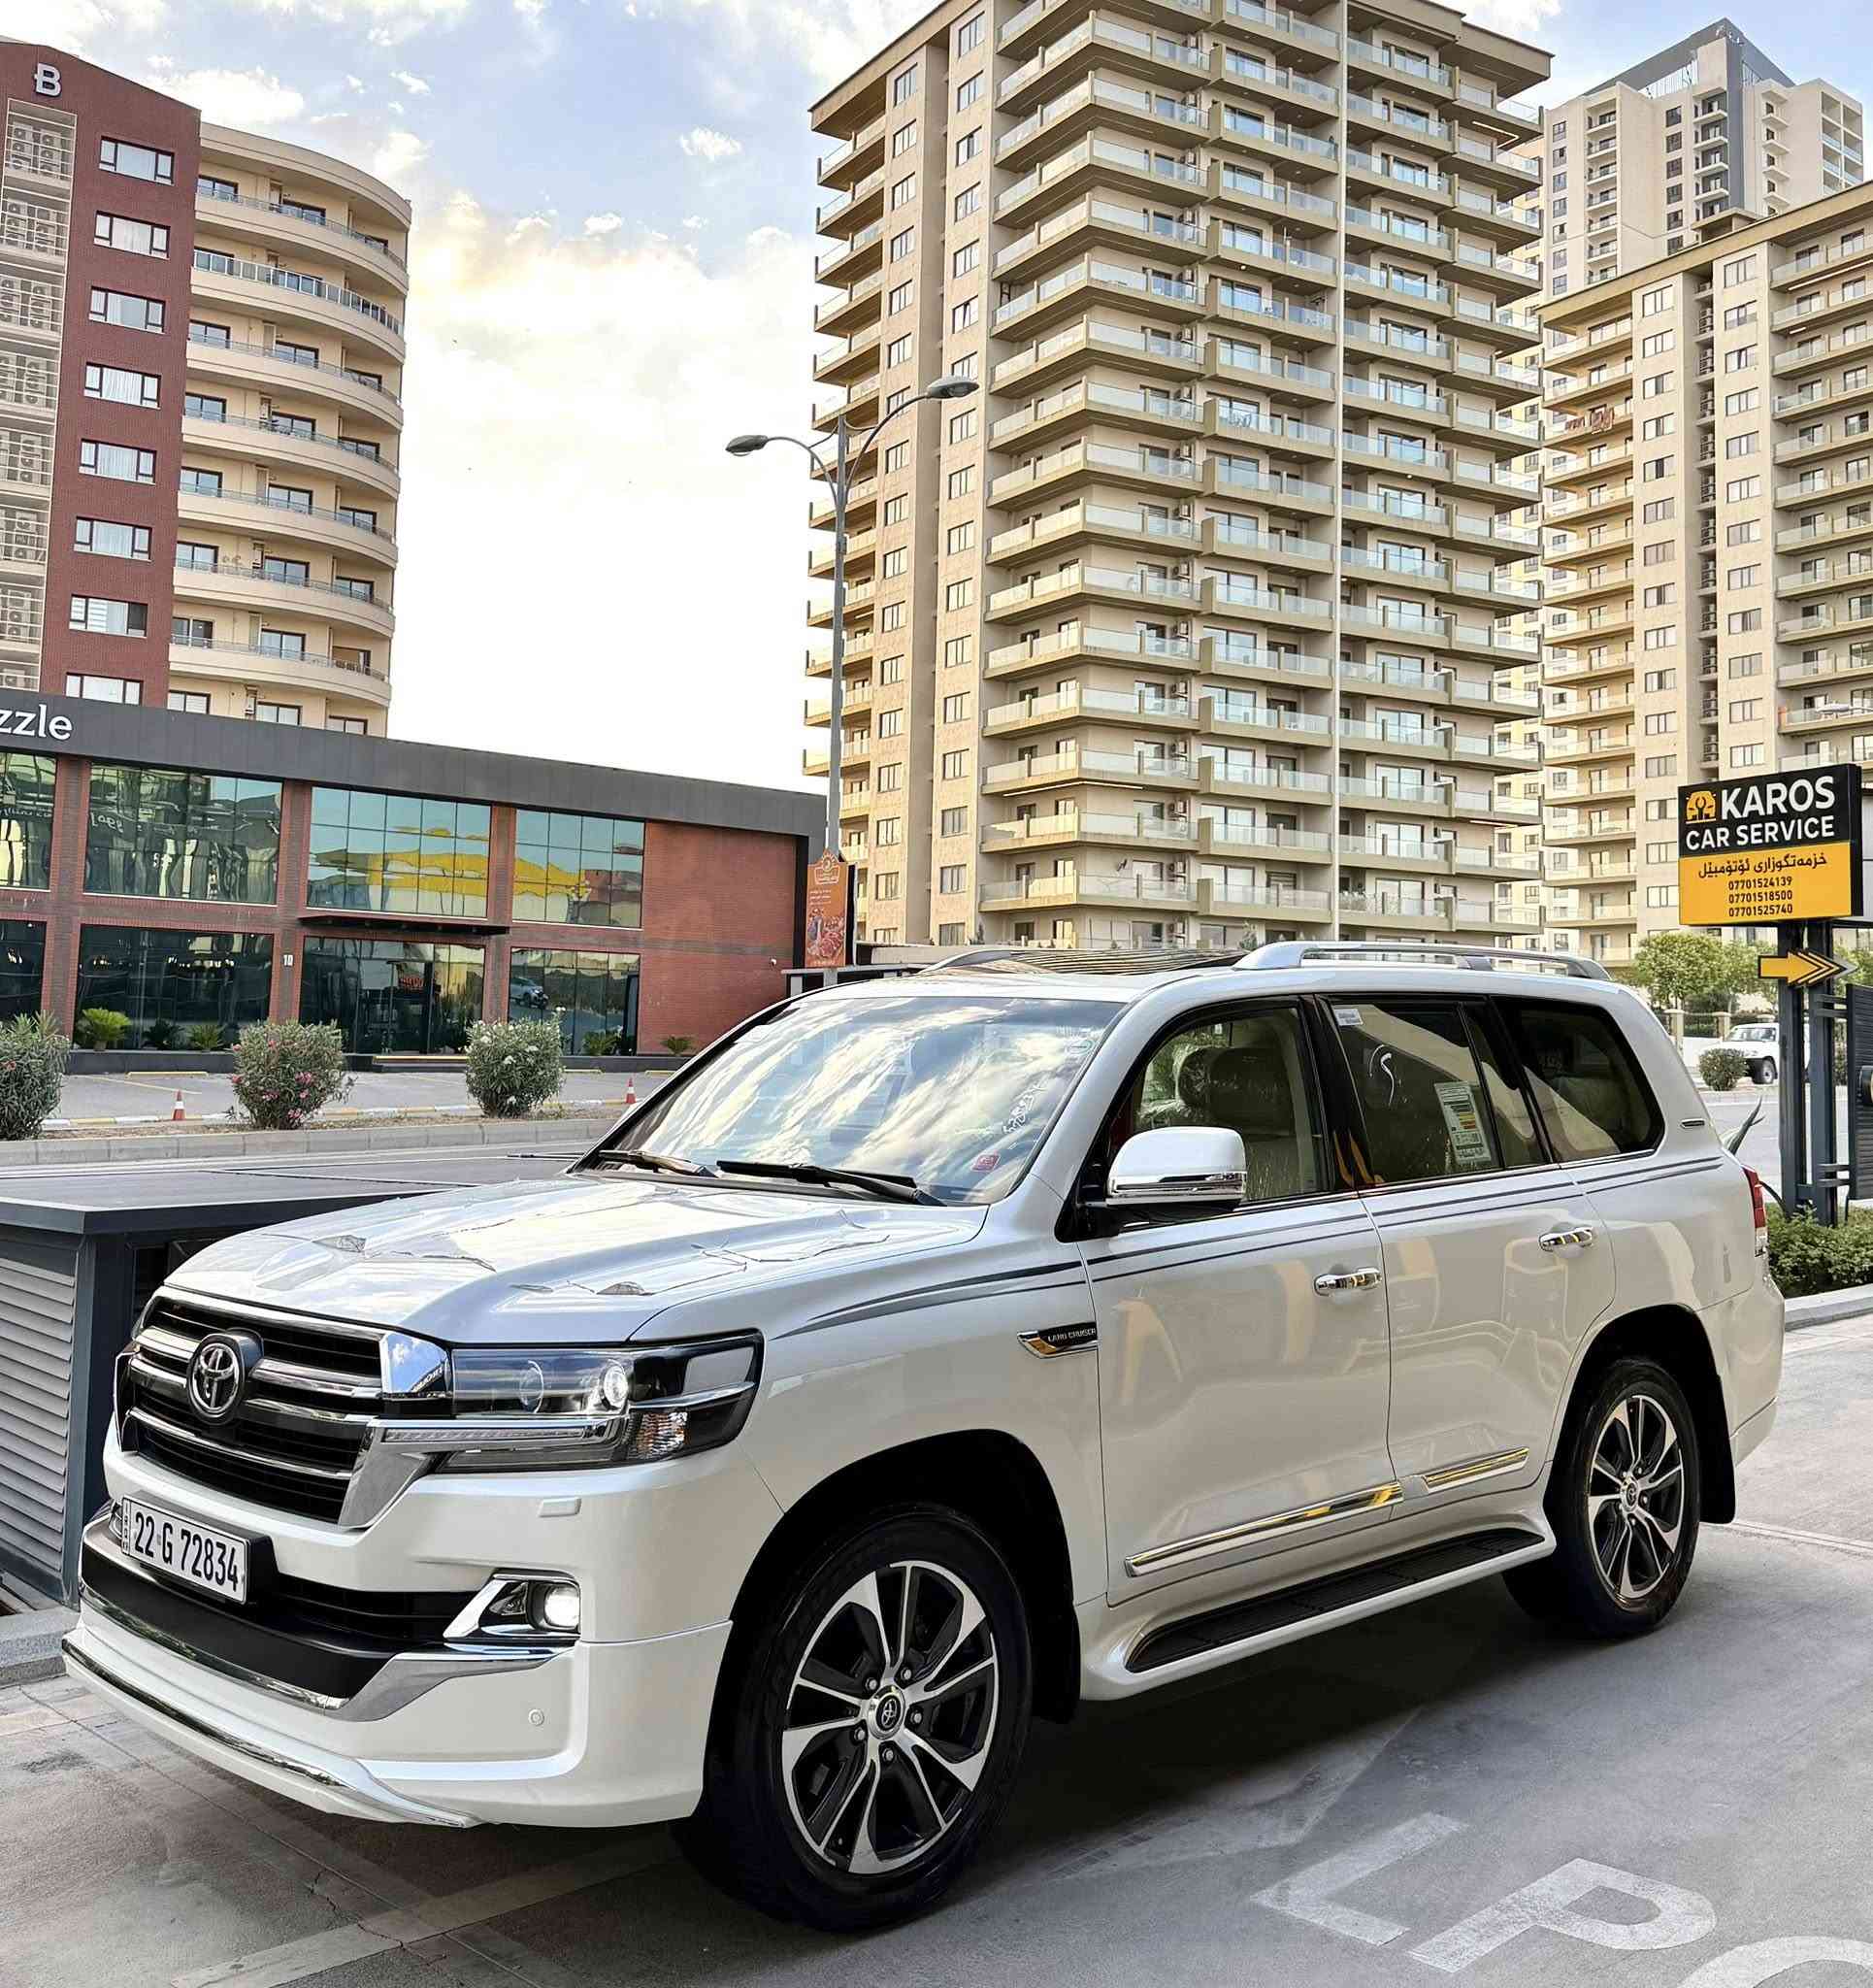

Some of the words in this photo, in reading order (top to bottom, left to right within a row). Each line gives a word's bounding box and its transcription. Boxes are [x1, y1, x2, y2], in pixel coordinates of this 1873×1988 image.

[34, 62, 61, 96] B
[1722, 776, 1835, 820] KAROS
[1686, 827, 1729, 850] CAR
[1736, 815, 1835, 846] SERVICE
[1728, 876, 1792, 890] 07701524139
[1728, 889, 1792, 904] 07701518500
[1728, 904, 1793, 917] 07701525740
[135, 1511, 155, 1558] 22
[162, 1522, 174, 1565] G
[181, 1528, 239, 1592] 72834
